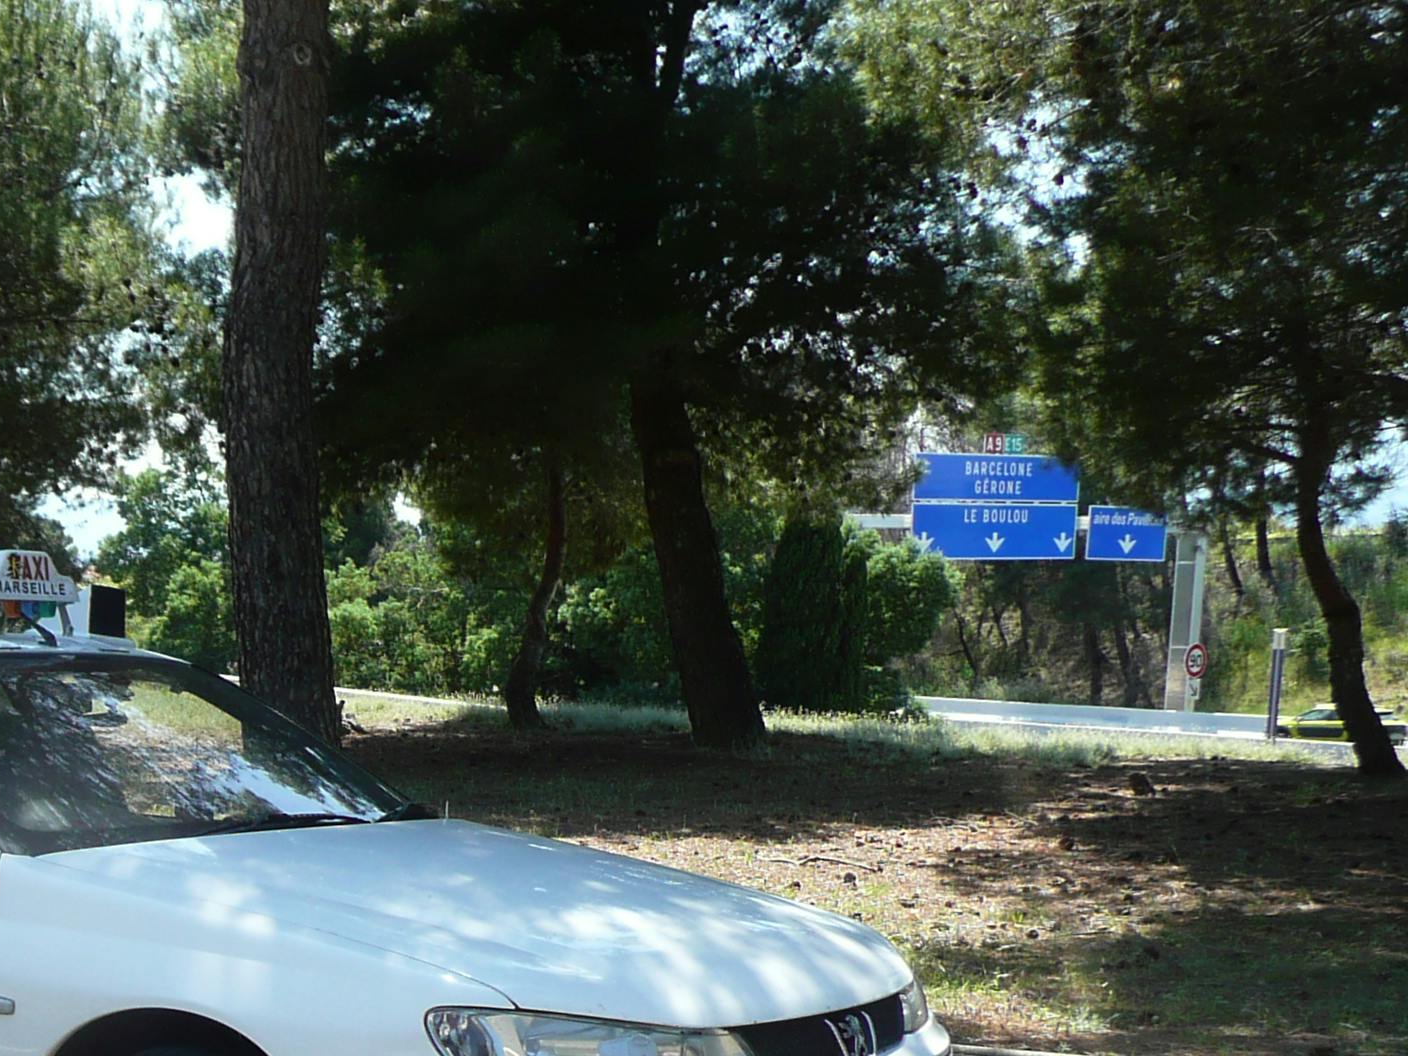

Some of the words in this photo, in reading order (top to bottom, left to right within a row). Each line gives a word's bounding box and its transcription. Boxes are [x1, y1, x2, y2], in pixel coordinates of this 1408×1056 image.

[1005, 437, 1023, 451] E15
[965, 461, 1033, 477] BARCELONE
[974, 477, 1022, 495] GÉRONE
[964, 508, 977, 523] LE
[983, 508, 1029, 523] BOULOU
[7, 555, 49, 581] TAXI
